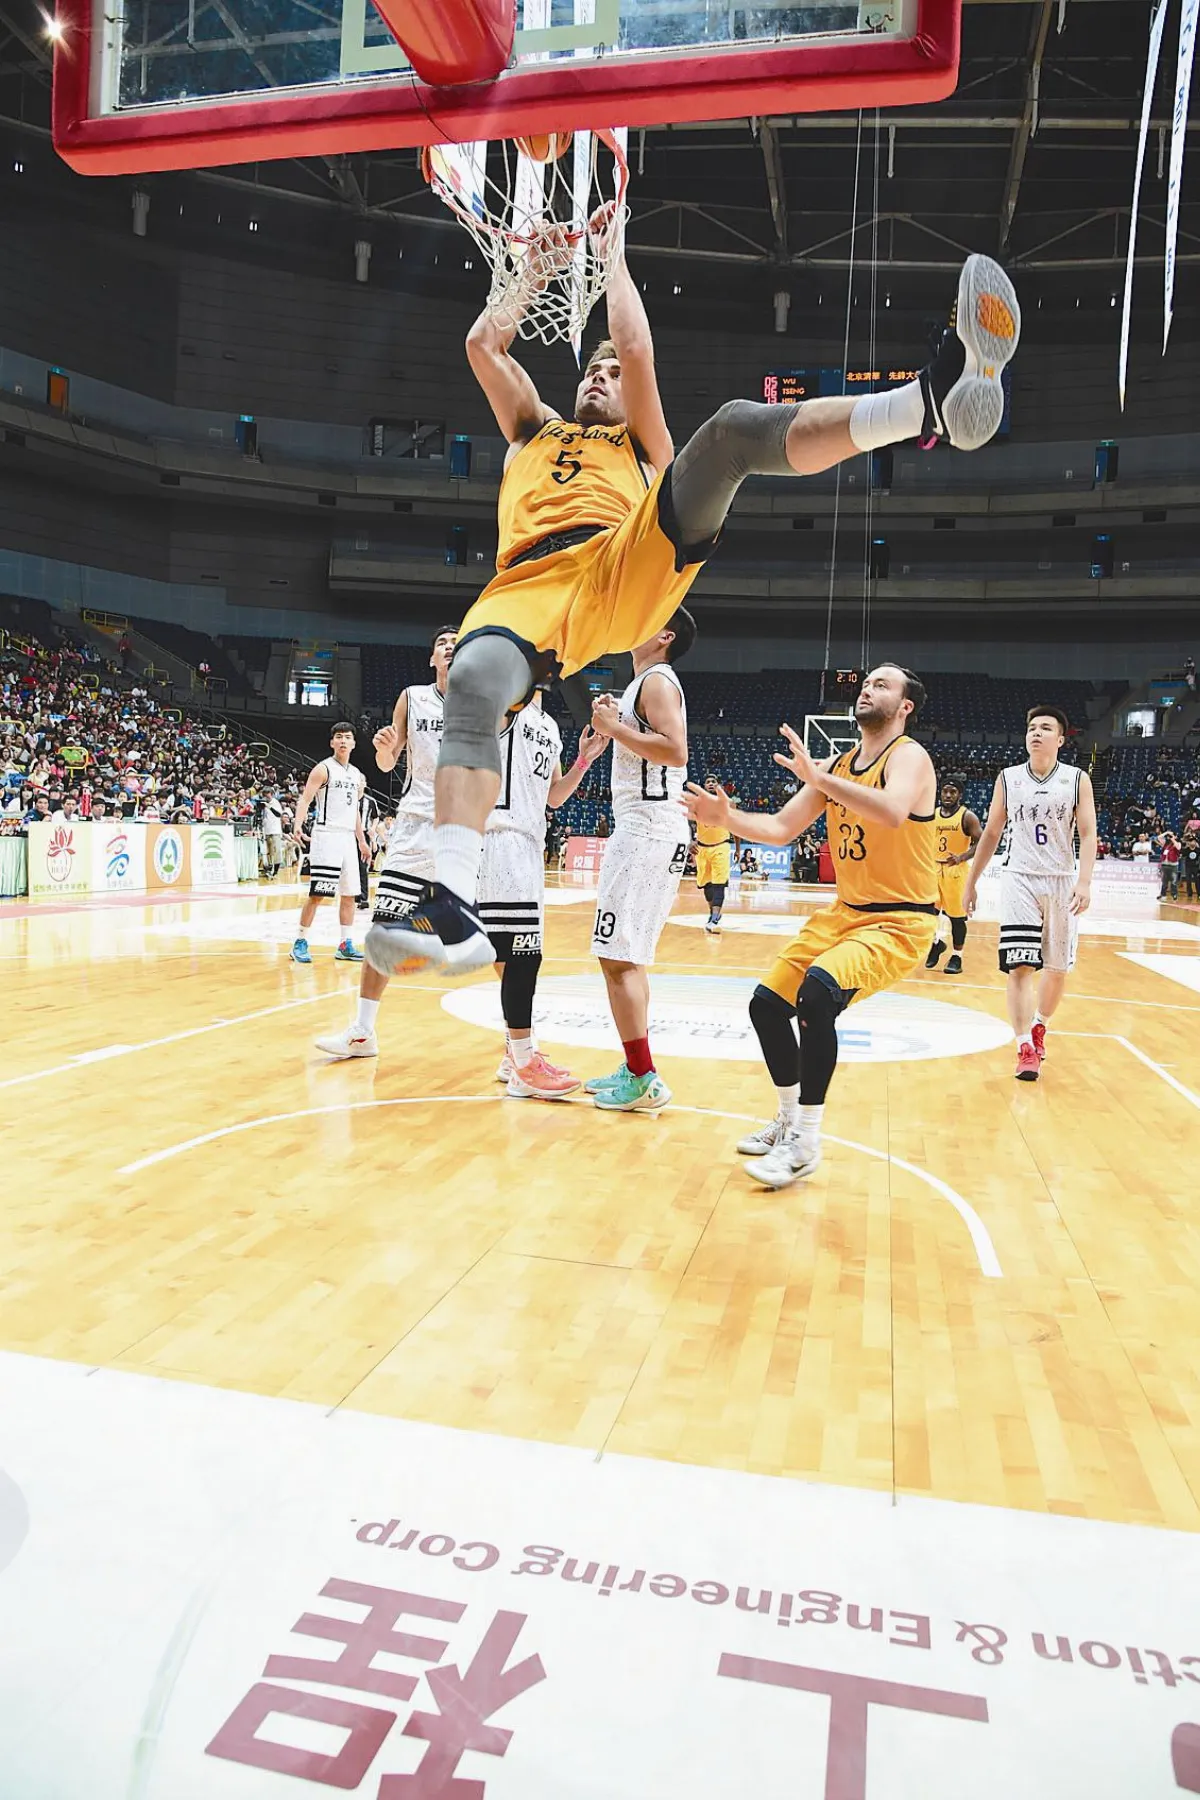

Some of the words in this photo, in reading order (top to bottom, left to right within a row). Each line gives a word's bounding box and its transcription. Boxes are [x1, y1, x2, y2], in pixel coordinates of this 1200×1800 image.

[551, 450, 583, 484] 5
[837, 673, 857, 683] 2:10
[346, 791, 353, 805] 5
[838, 823, 867, 861] 33
[939, 837, 947, 852] 3
[1035, 824, 1048, 845] 6
[594, 909, 616, 938] 13
[350, 1518, 501, 1572] Corp.
[511, 1544, 931, 1650] Engineering
[953, 1620, 1009, 1666] &
